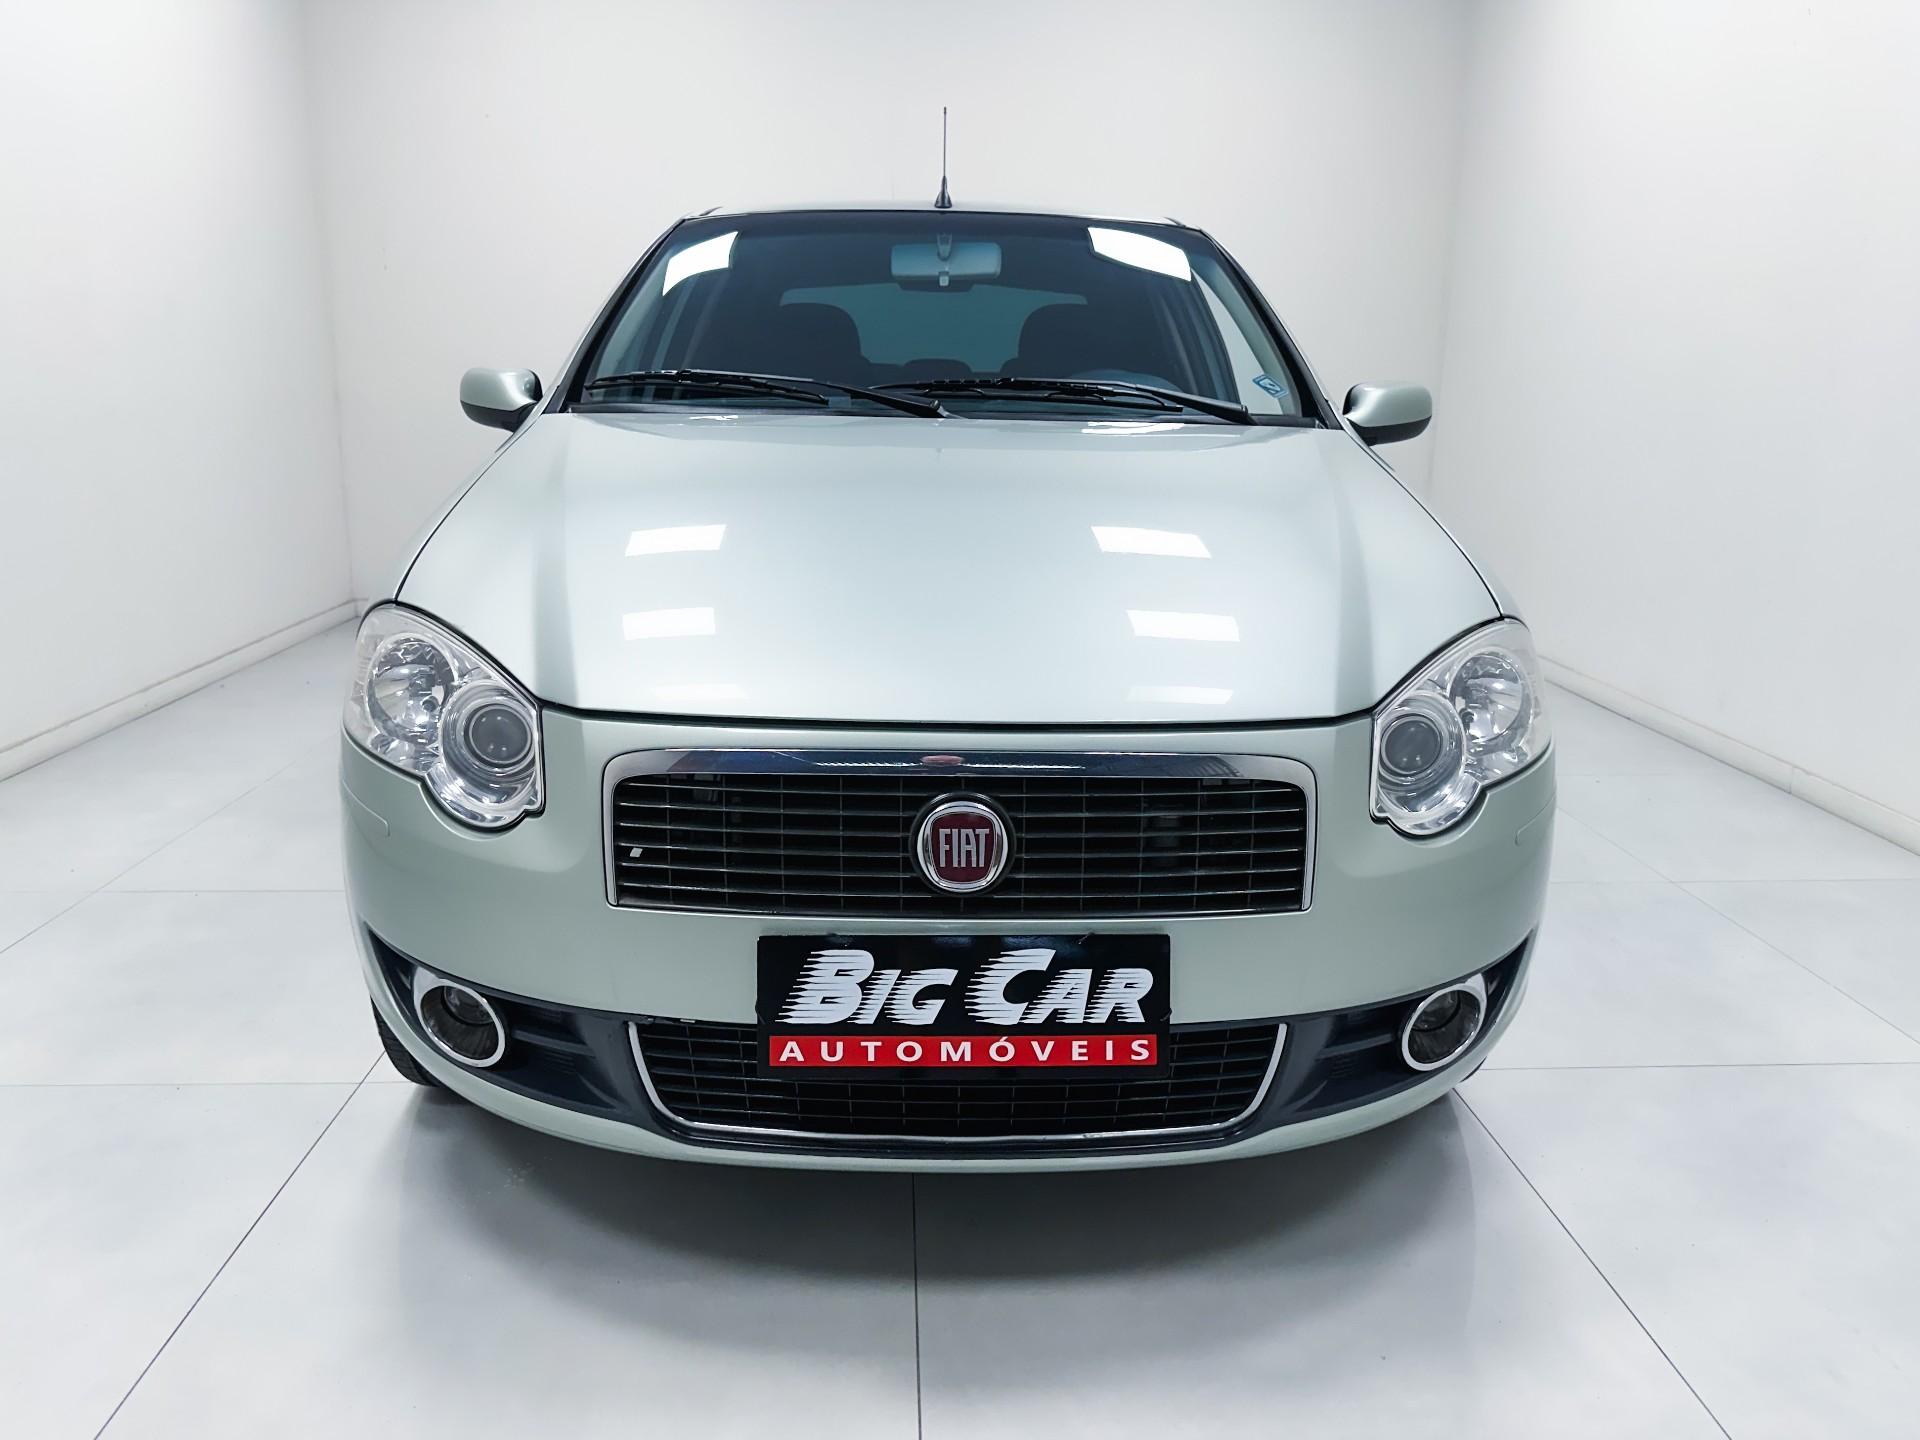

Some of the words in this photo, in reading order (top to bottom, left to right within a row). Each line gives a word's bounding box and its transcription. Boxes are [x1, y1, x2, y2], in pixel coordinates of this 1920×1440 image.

[939, 828, 990, 868] FIAT
[774, 948, 958, 1025] BIG
[964, 947, 1154, 1026] CAR
[779, 1036, 1150, 1063] AUTOMÓVEIS
